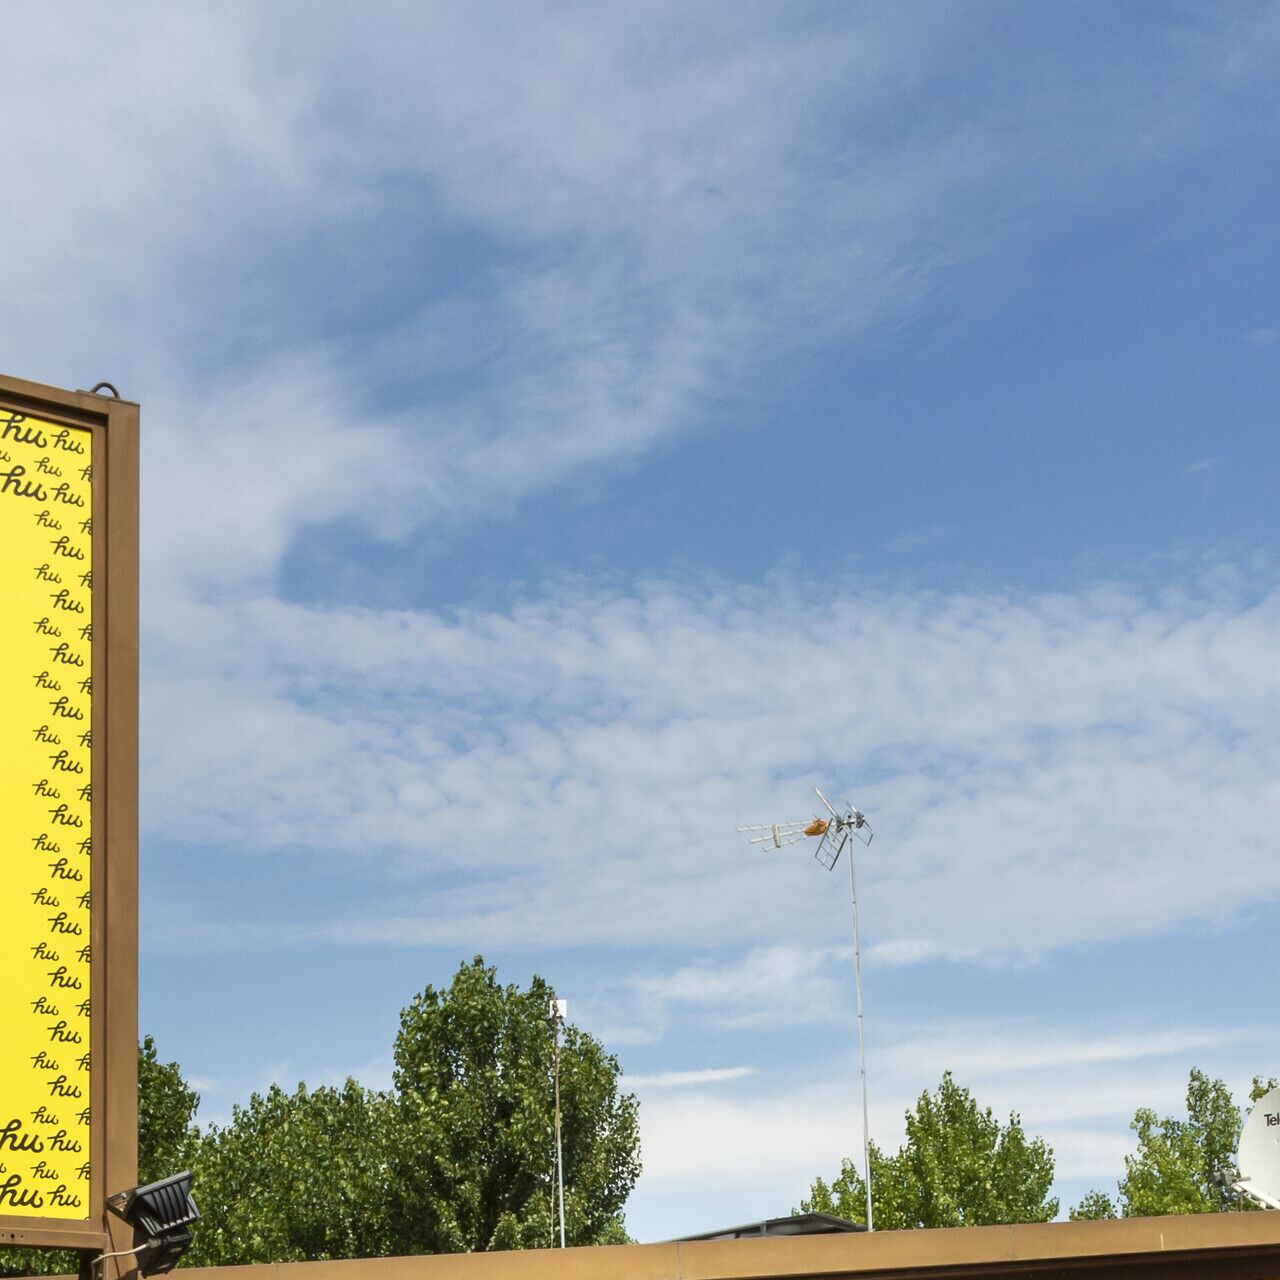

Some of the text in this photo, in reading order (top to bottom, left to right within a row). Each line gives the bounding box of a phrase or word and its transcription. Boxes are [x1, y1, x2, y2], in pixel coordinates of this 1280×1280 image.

[51, 427, 84, 454] hu
[51, 483, 84, 507] hu
[51, 536, 84, 560] hu
[50, 589, 84, 613] hu
[50, 643, 84, 667] hu
[49, 696, 83, 720] hu
[47, 1075, 81, 1098] hu
[47, 1130, 81, 1152] hu
[47, 1185, 81, 1207] hu
